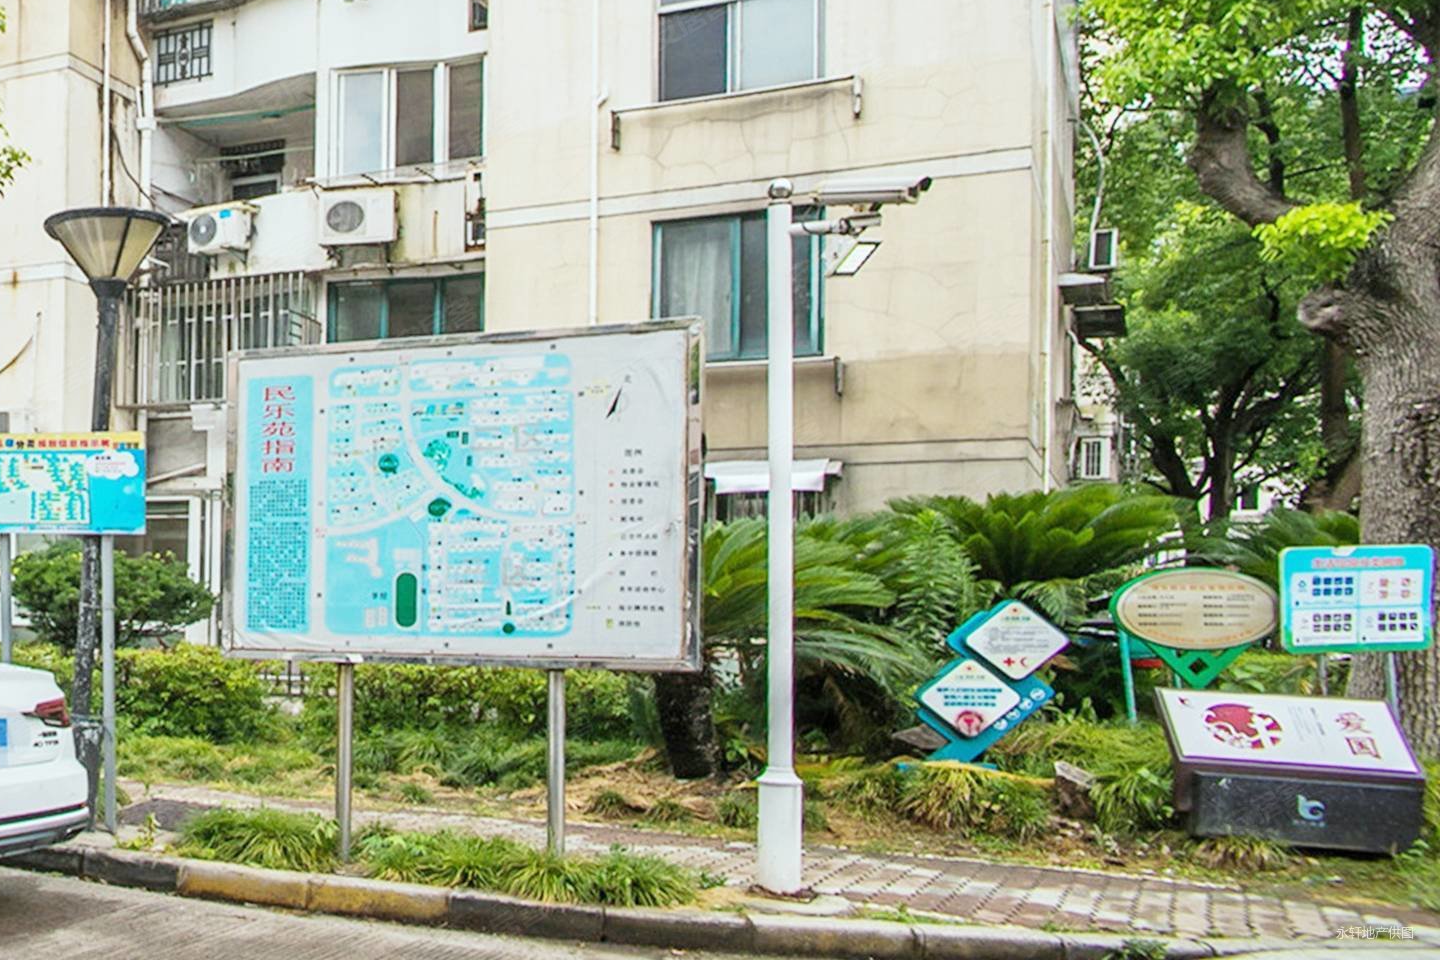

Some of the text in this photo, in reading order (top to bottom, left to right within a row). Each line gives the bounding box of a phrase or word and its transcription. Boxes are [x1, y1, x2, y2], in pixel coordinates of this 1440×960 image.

[262, 385, 296, 473] 民乐苑指南
